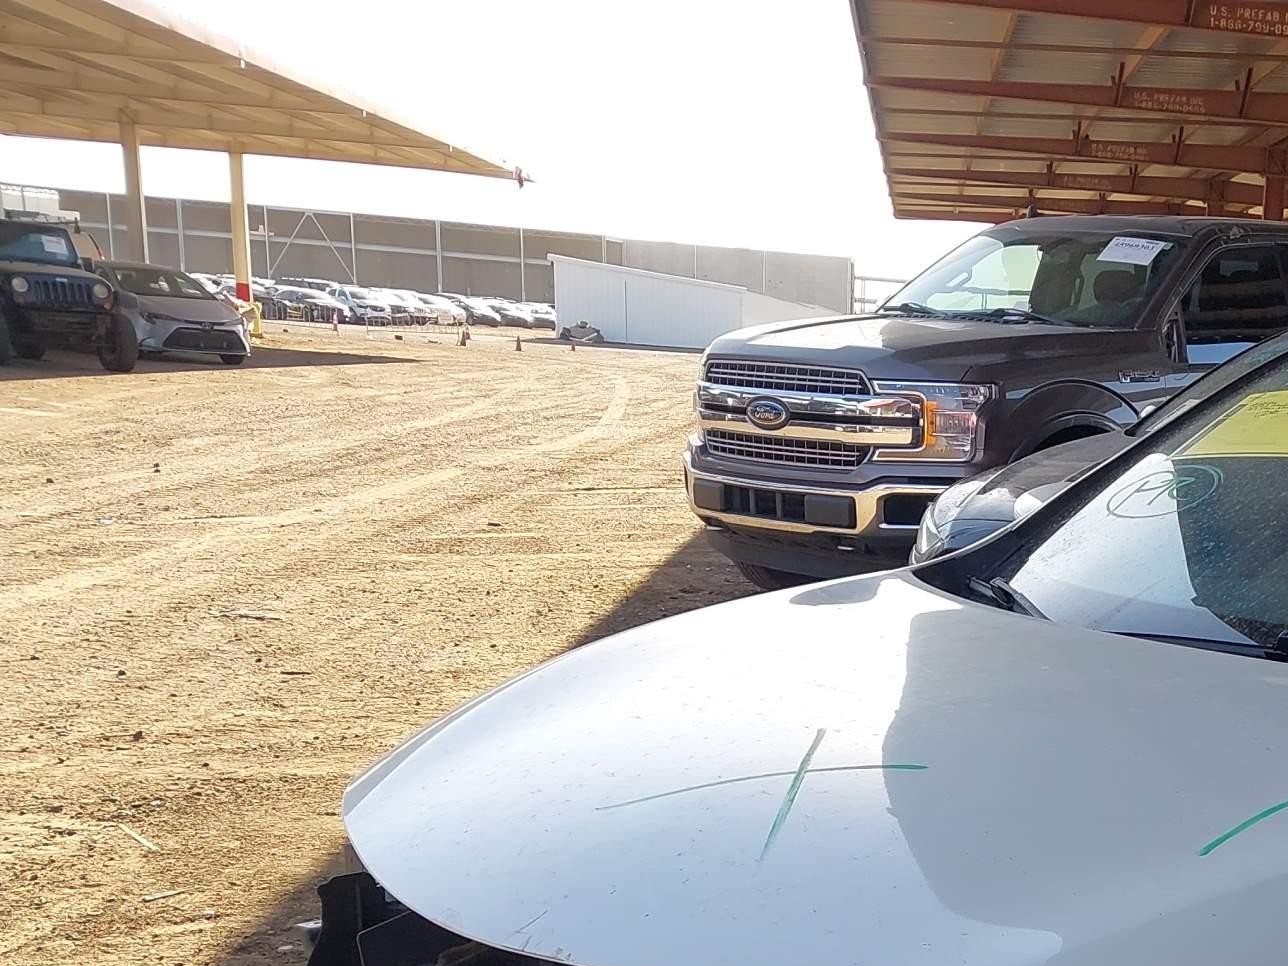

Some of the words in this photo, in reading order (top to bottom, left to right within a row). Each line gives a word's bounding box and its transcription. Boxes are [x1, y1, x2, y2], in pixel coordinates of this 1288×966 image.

[1210, 4, 1231, 18] U.S.
[1236, 7, 1280, 22] PREFAB
[754, 405, 779, 420] Ford
